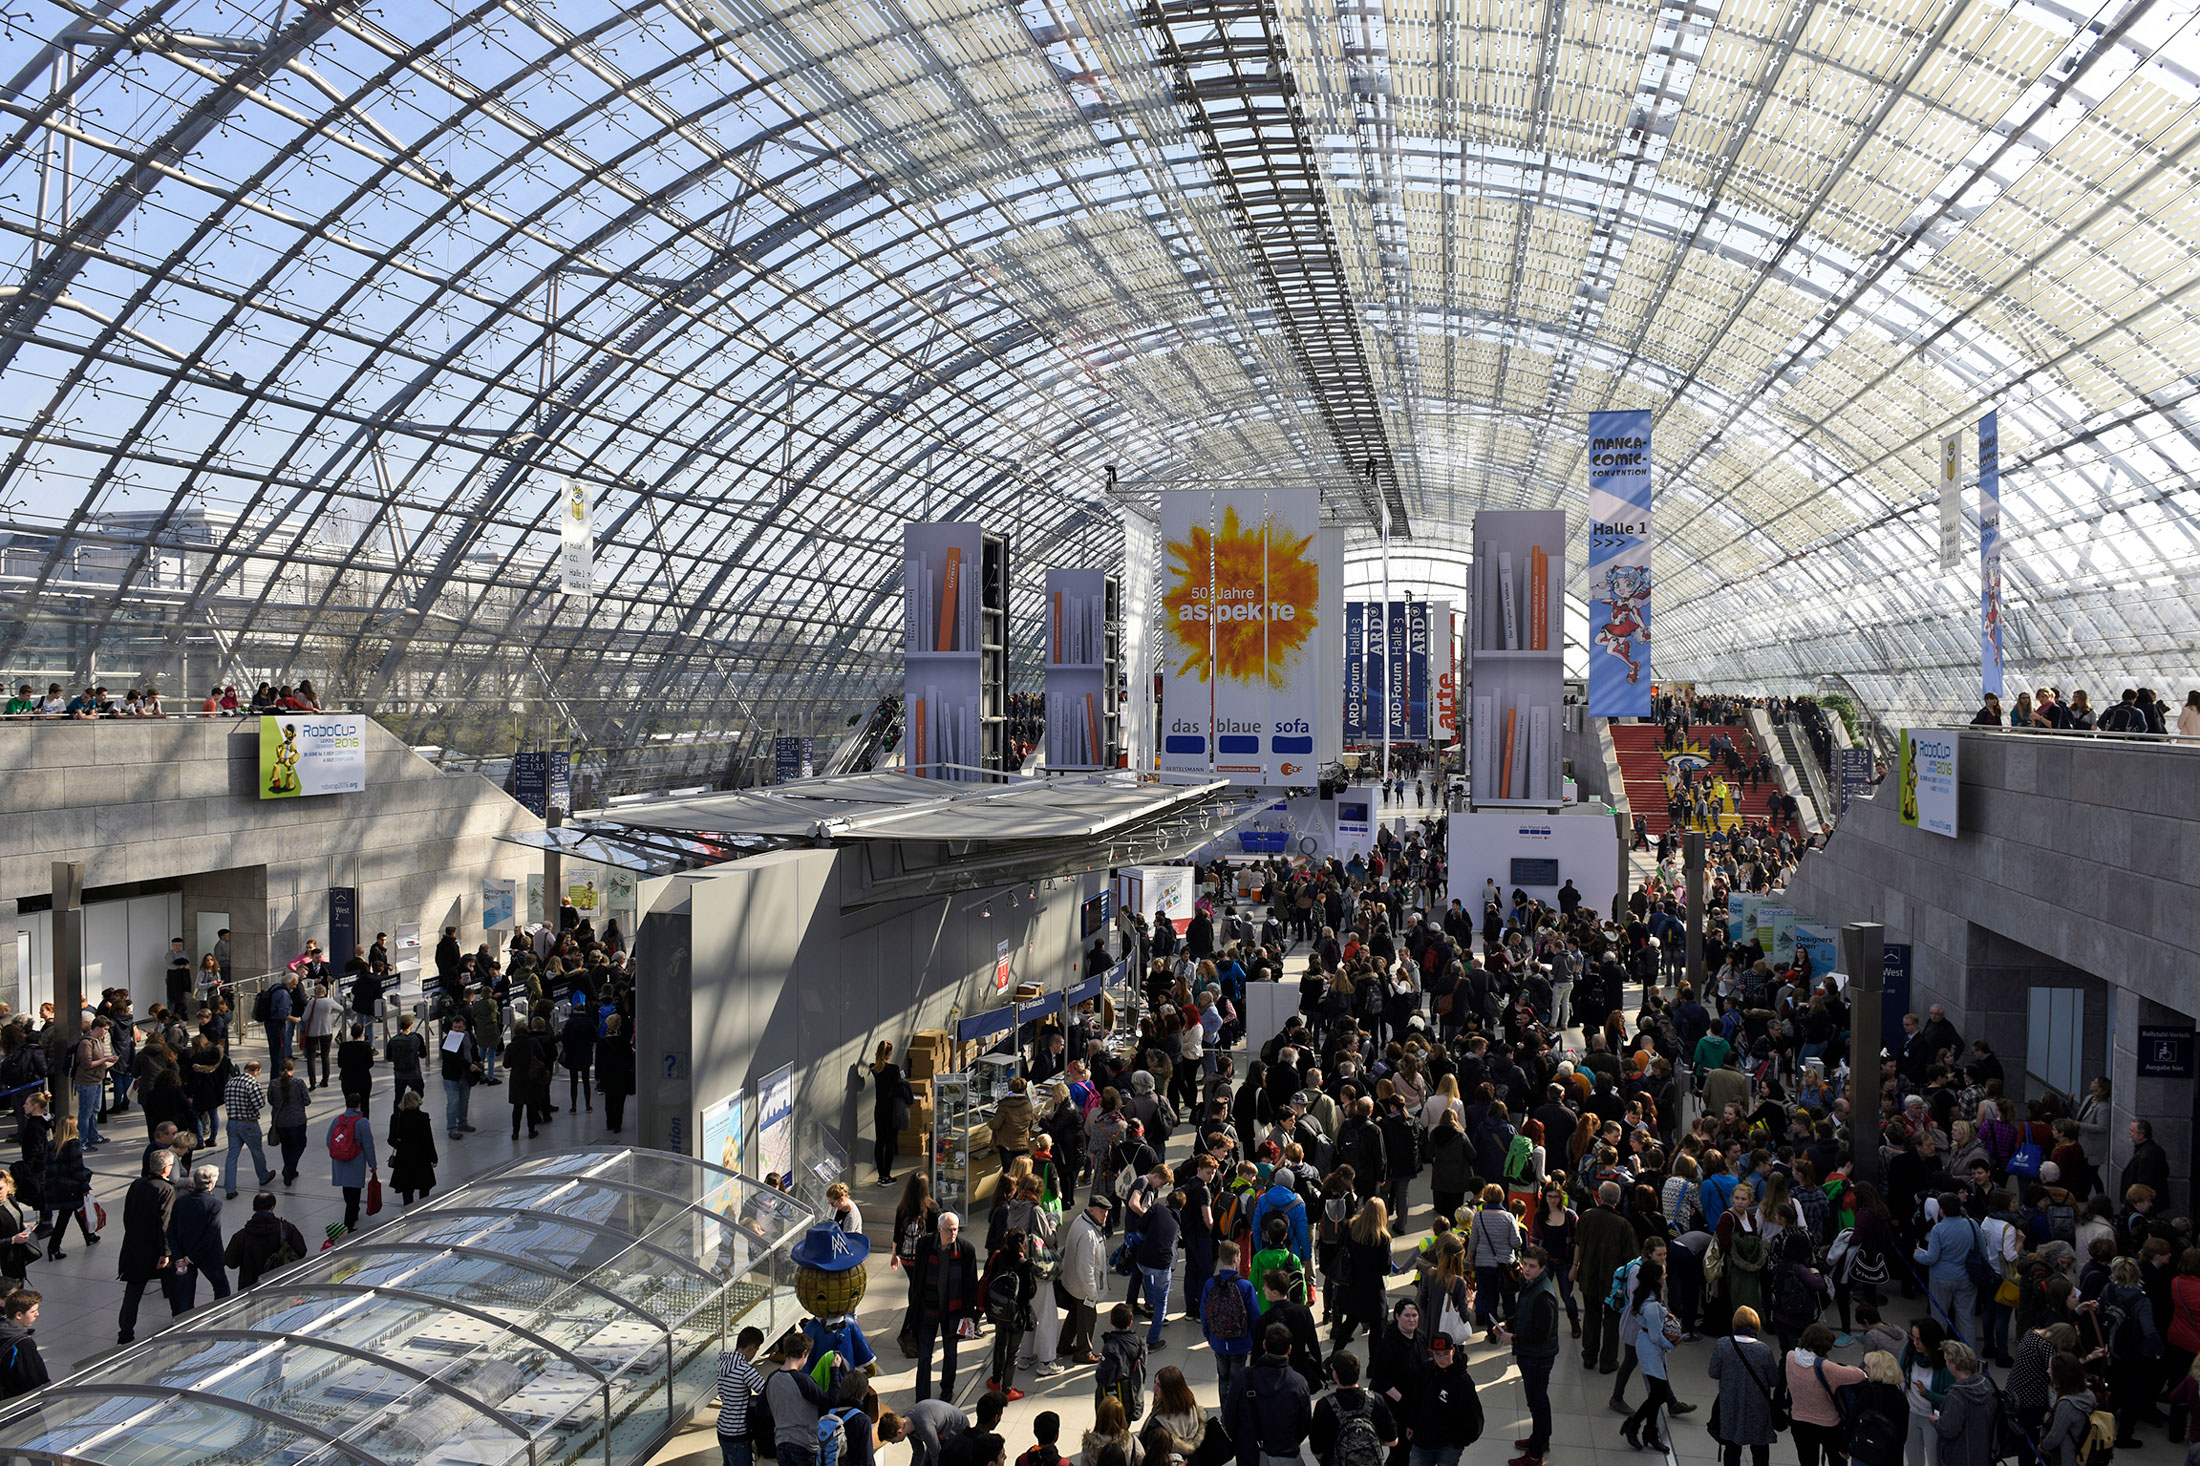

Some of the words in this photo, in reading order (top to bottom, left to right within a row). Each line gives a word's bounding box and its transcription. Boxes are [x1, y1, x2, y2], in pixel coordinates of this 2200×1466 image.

[1592, 437, 1647, 450] MANGA-
[1593, 522, 1634, 535] Halle
[1639, 522, 1647, 534] 1
[1981, 518, 1995, 530] Halle
[569, 569, 582, 577] Halle
[1192, 587, 1208, 599] 50
[1216, 588, 1255, 600] Jahre
[1178, 602, 1296, 623] aspekte
[1350, 628, 1360, 656] Halle
[1370, 618, 1383, 656] ARD
[1392, 626, 1402, 655] Halle
[1412, 618, 1425, 656] ARD
[1349, 662, 1360, 727] ARD-Forum
[1392, 662, 1402, 727] ARD-Forum
[1436, 673, 1453, 729] arte
[303, 724, 356, 737] RoboCup
[1172, 718, 1200, 733] das
[1217, 718, 1261, 733] blaue
[1276, 718, 1310, 734] sofa
[335, 738, 359, 748] 2016
[1920, 740, 1951, 759] RoboCup
[1937, 762, 1952, 776] 2016
[485, 888, 512, 896] Designers'
[335, 906, 350, 914] West
[1796, 936, 1835, 944] Designers'
[1882, 968, 1904, 977] West
[1019, 998, 1046, 1012] DB-Umtausch
